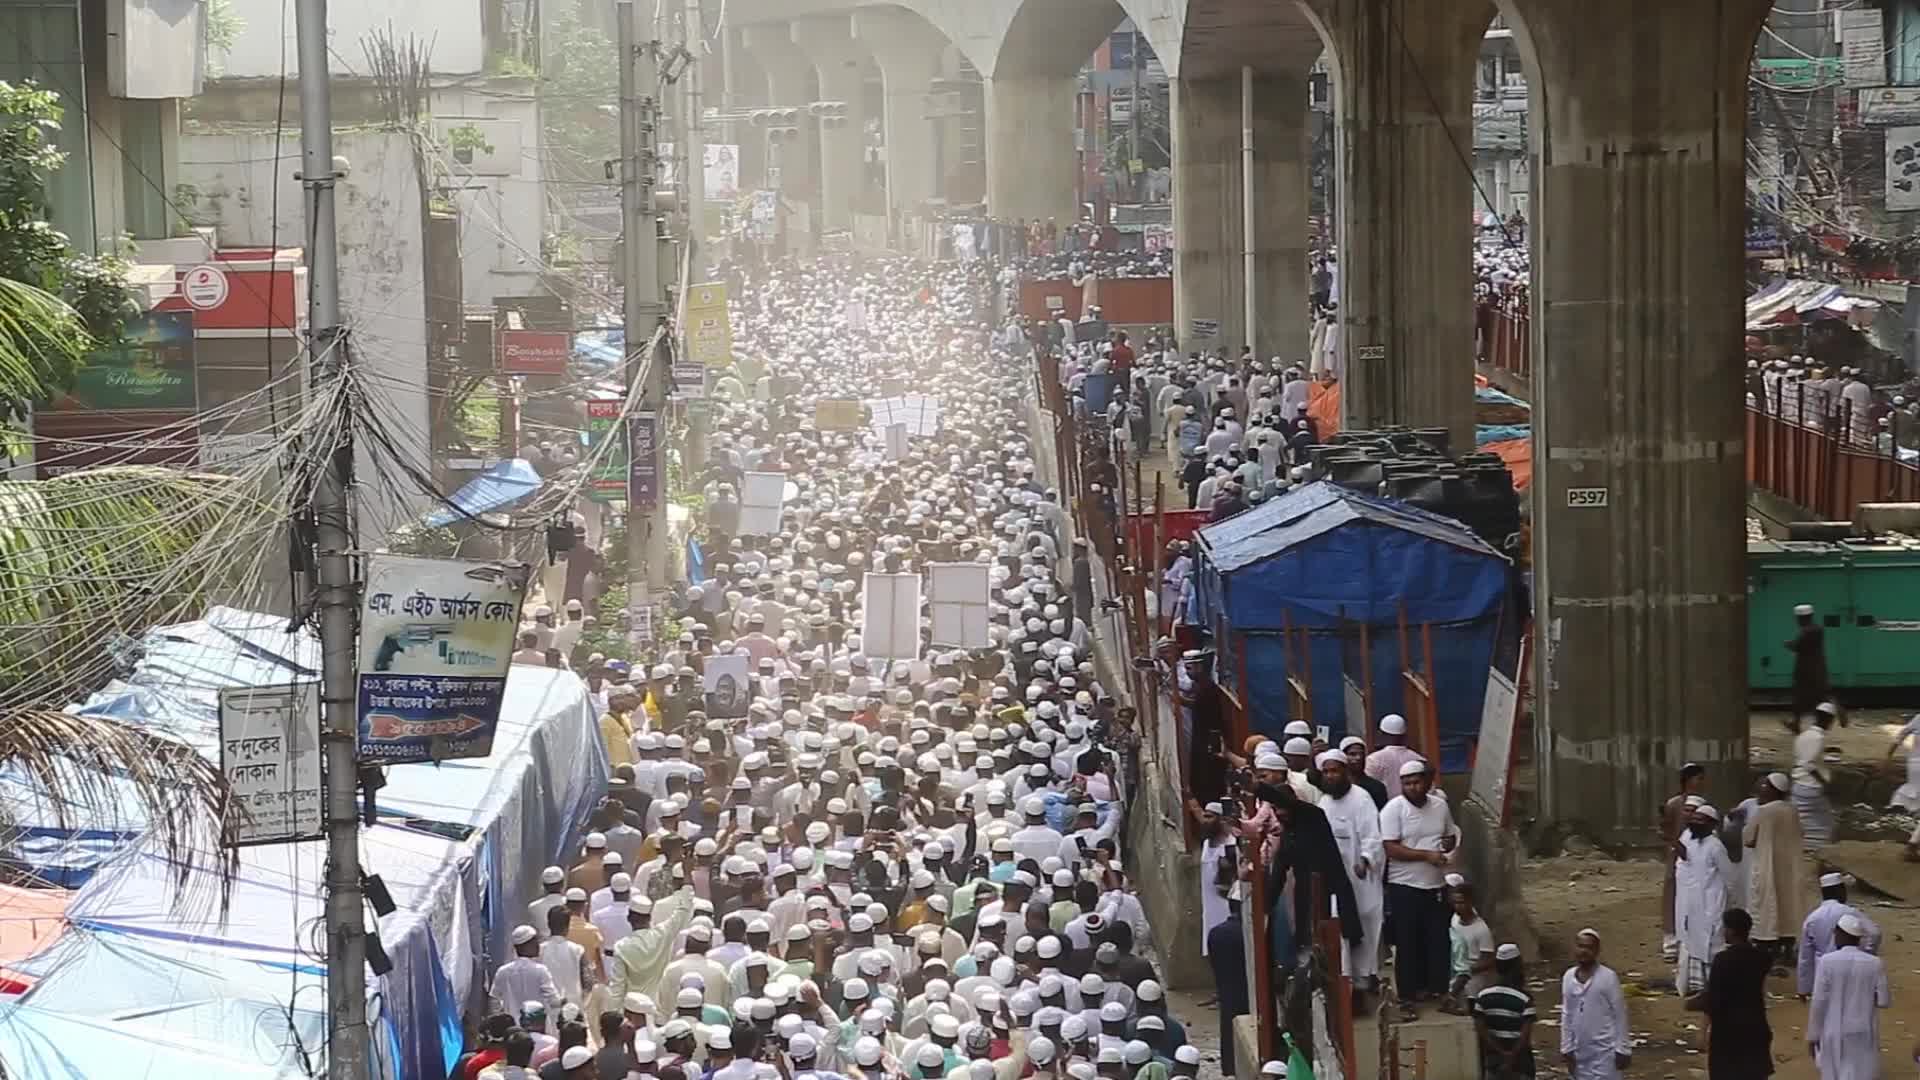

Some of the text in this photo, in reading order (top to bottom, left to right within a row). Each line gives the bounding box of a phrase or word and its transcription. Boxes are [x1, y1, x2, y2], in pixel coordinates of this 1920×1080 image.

[1569, 491, 1606, 504] P597
[402, 591, 436, 619] এইচ
[439, 592, 482, 620] আর্মস
